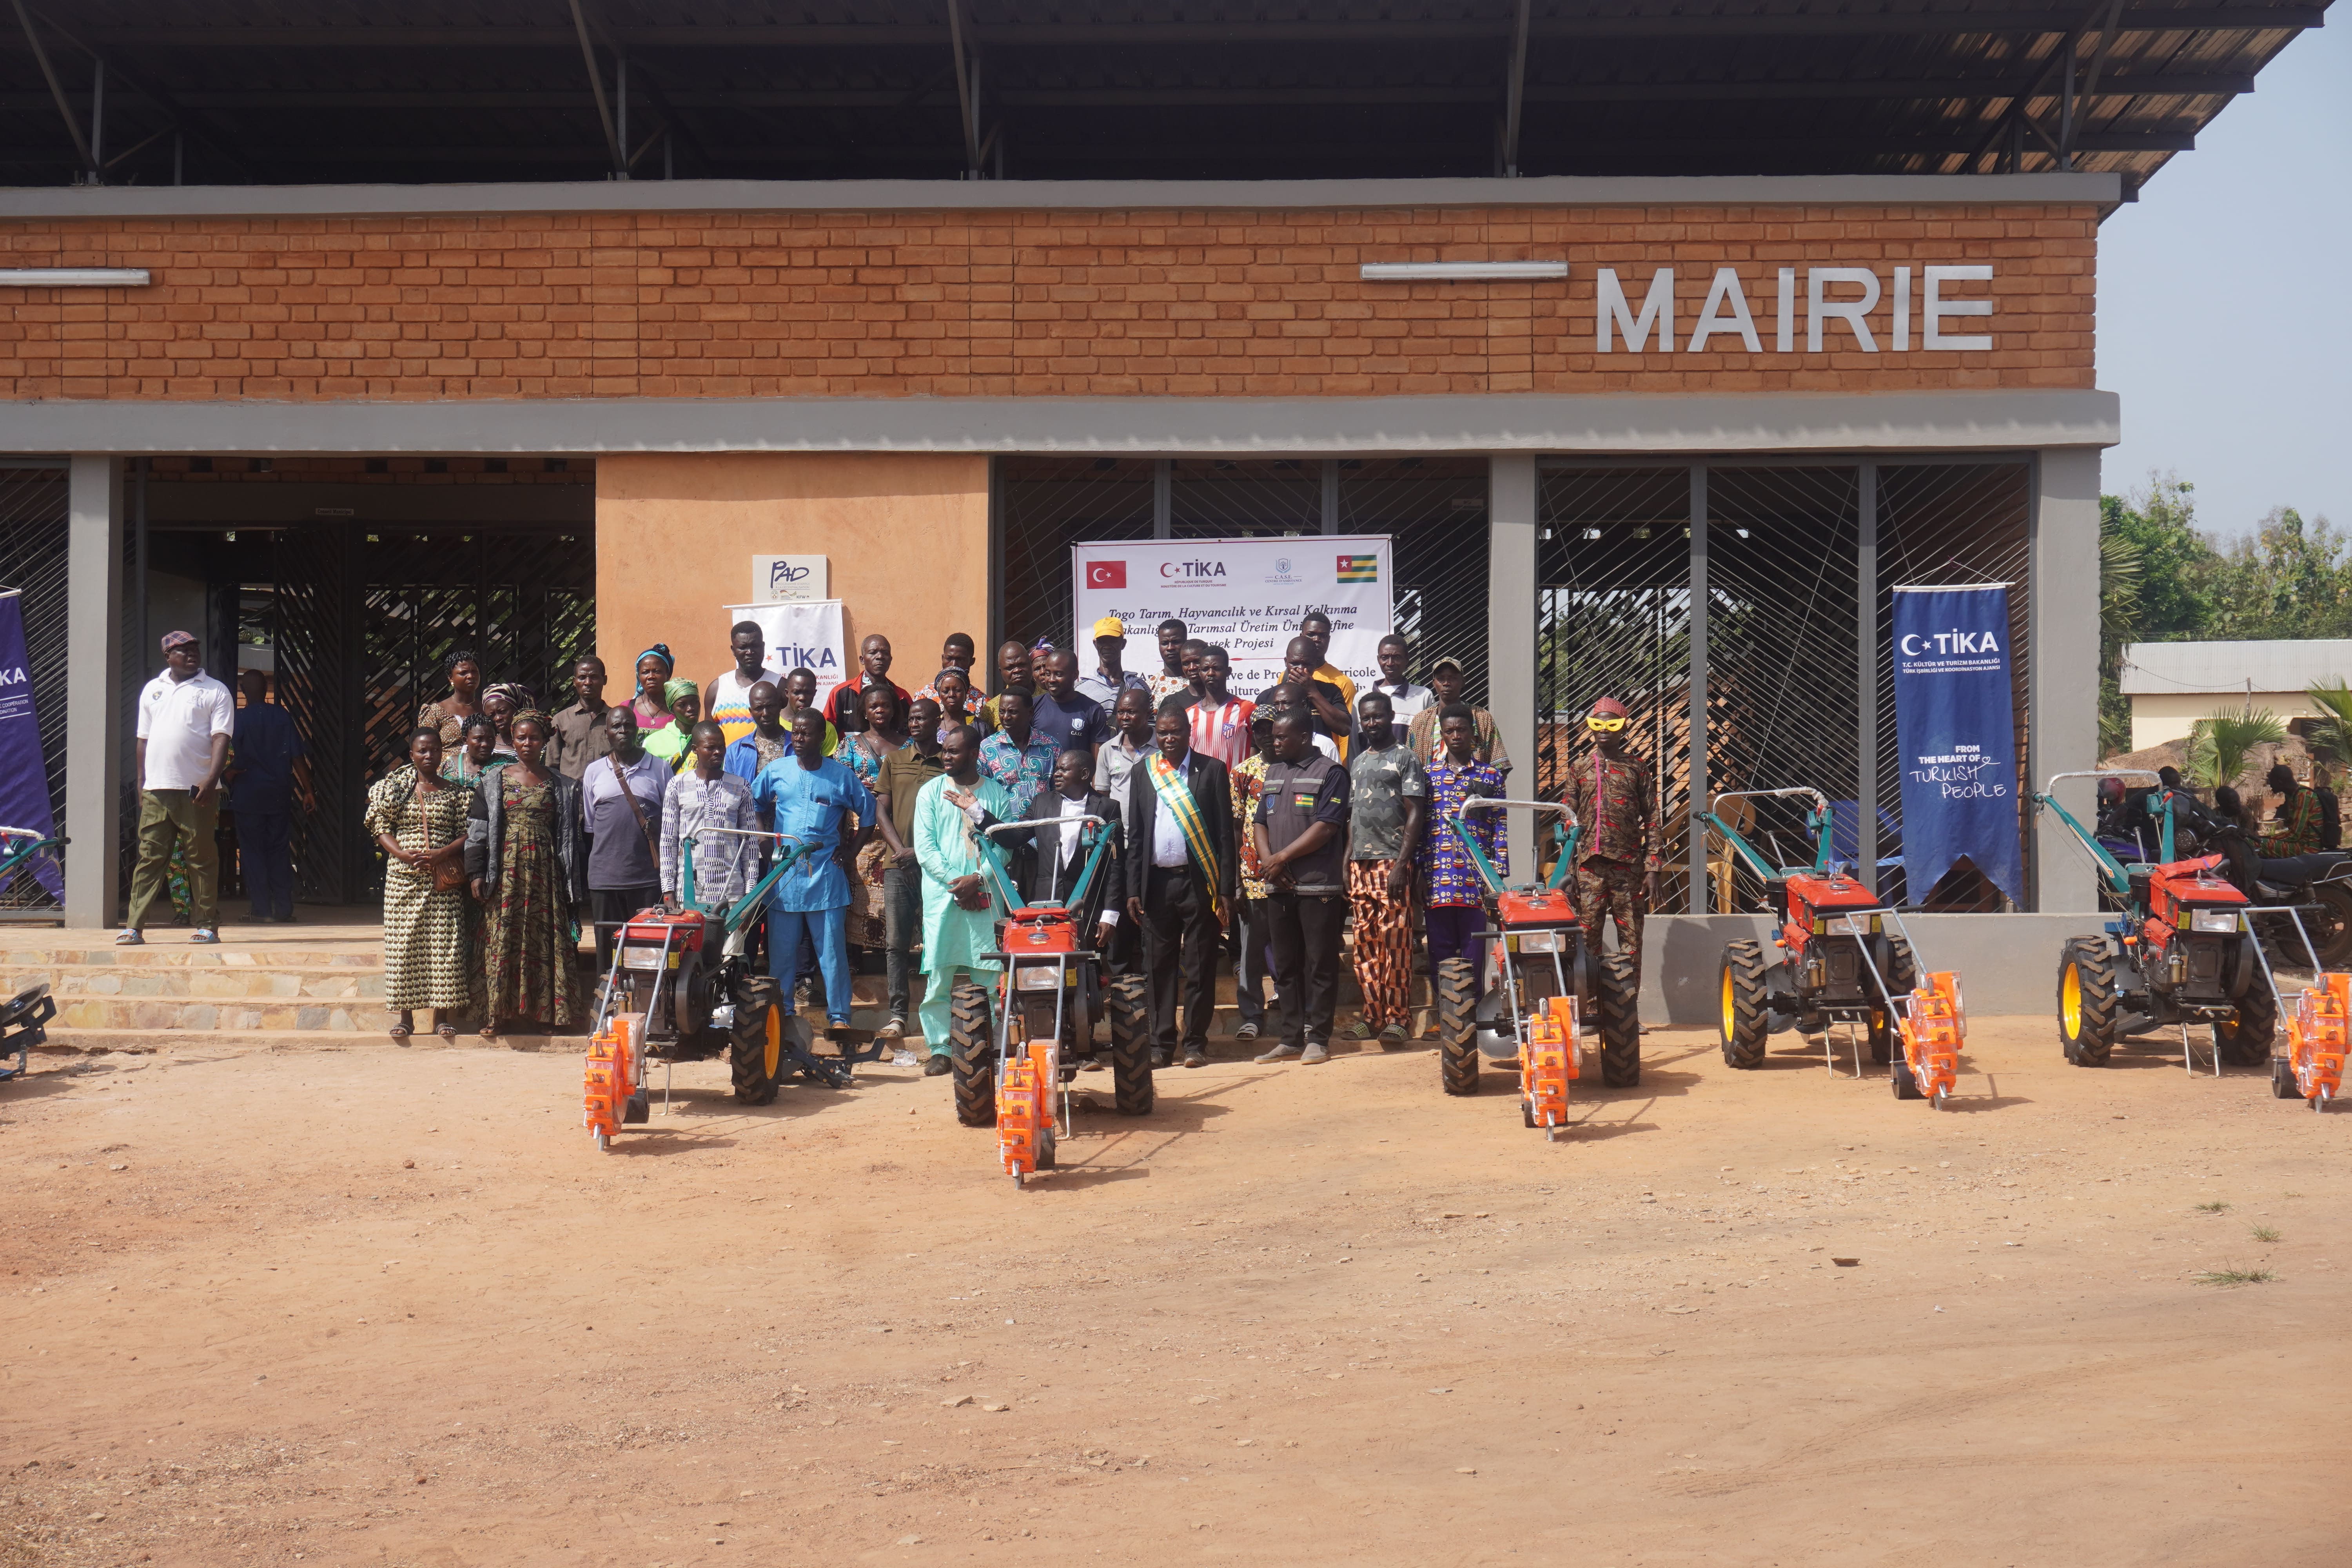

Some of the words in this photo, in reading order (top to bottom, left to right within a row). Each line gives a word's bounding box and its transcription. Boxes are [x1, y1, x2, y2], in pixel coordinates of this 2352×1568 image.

[1597, 265, 1993, 352] MAIRIE
[770, 561, 809, 589] PAD
[1182, 559, 1227, 577] TİKA
[1109, 609, 1135, 621] Togo
[1178, 606, 1246, 620] Hayvancılık
[1265, 605, 1301, 616] Kırsal
[1188, 622, 1236, 633] Tarımsal
[1240, 620, 1278, 632] Üretim
[1234, 638, 1274, 650] Projesi
[1934, 628, 2000, 654] TİKA
[775, 642, 837, 668] TİKA
[1247, 669, 1260, 679] de
[1227, 686, 1260, 695] ulture
[2, 699, 29, 708] COOPÉRATION
[1955, 745, 1980, 753] FROM
[1938, 755, 1967, 763] HEART
[1909, 765, 1978, 782] TURKISH
[1942, 782, 2006, 799] PEOPLE
